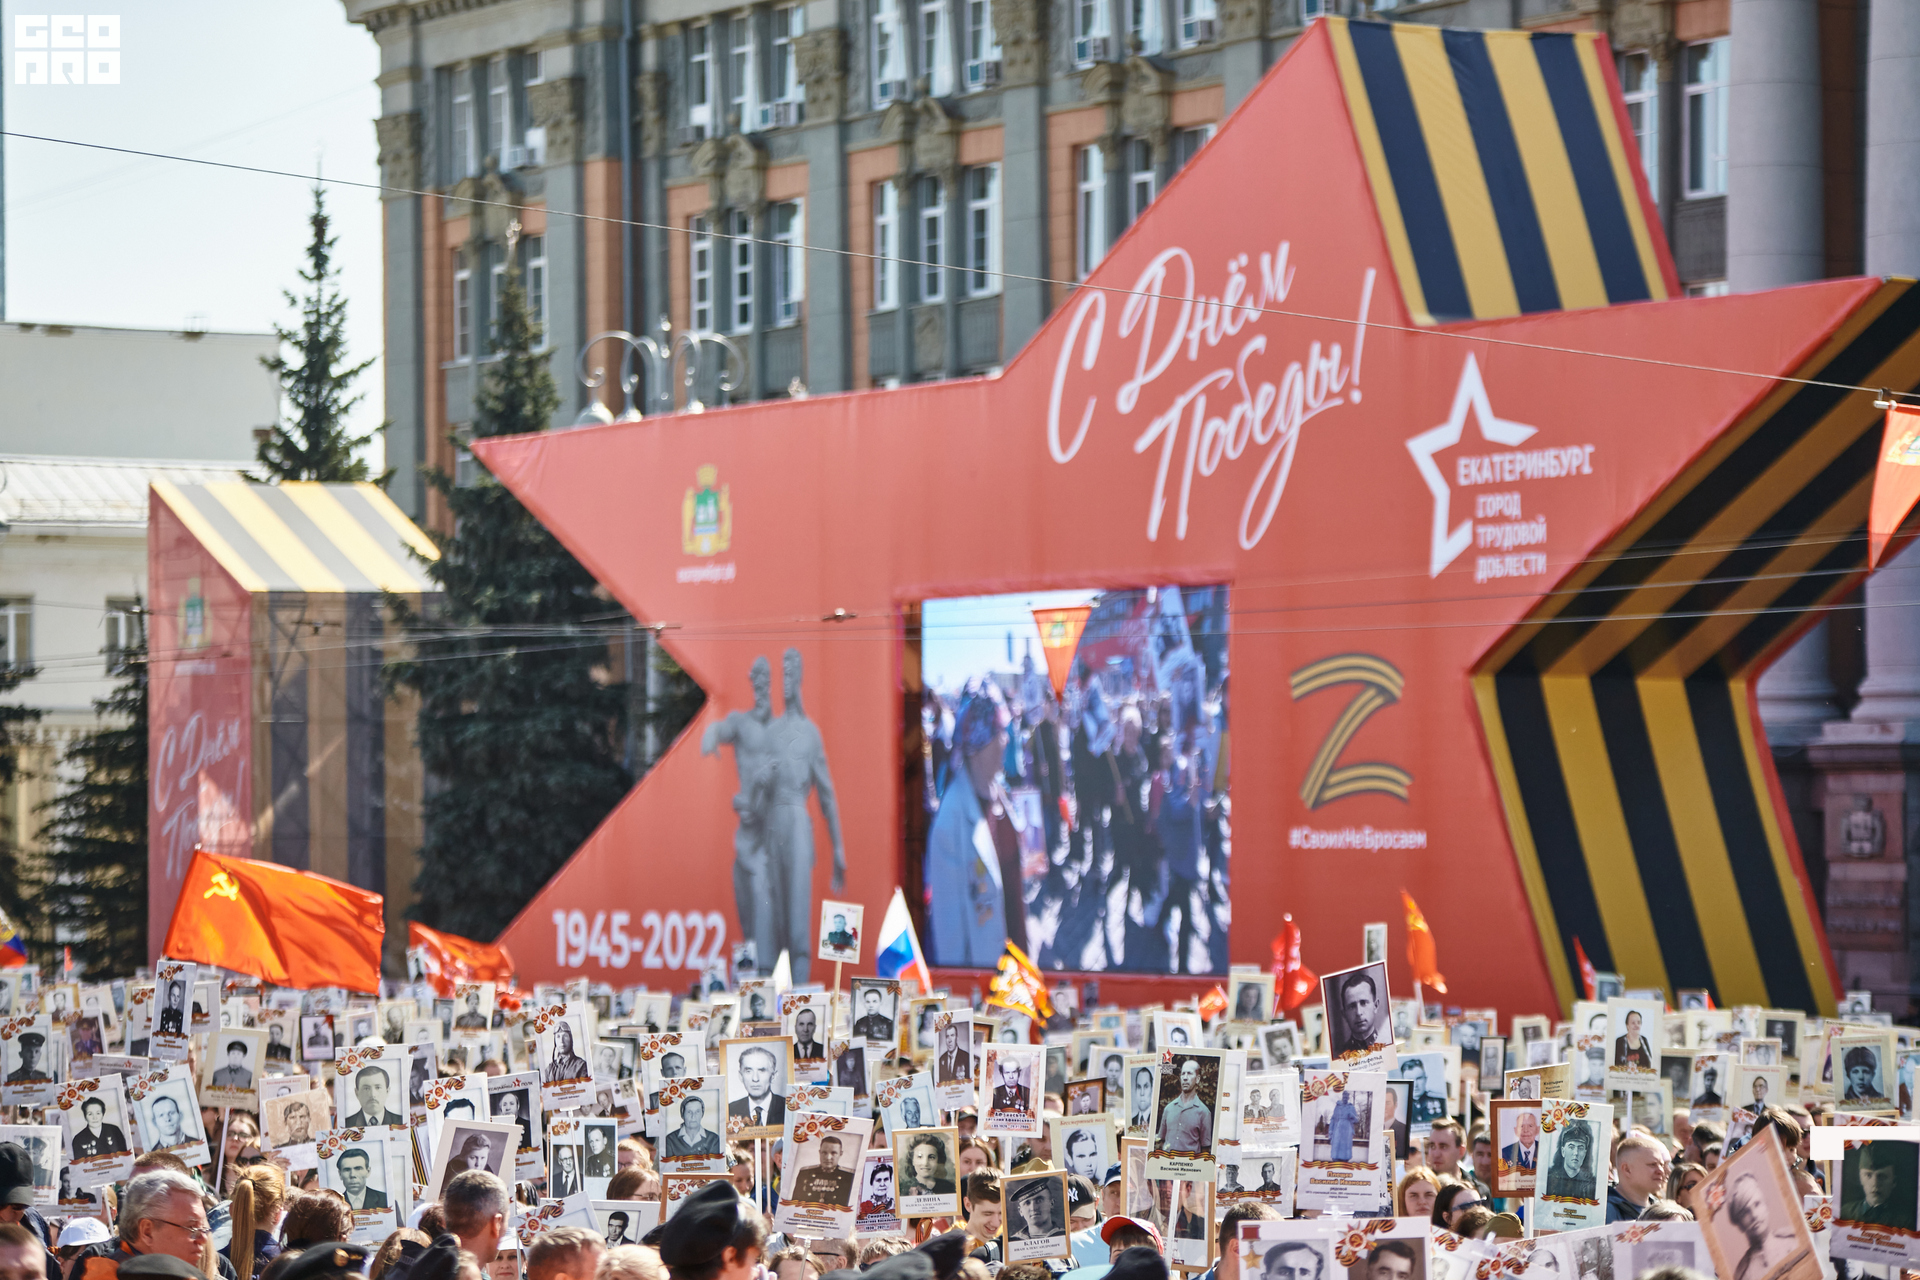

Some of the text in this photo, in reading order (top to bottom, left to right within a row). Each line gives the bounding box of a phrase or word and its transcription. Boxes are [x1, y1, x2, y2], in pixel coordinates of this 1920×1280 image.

[1048, 241, 1297, 464] С Днём
[1135, 268, 1377, 550] Победы!
[1456, 443, 1595, 487] ЕКАТЕРИНБУРГ
[1475, 491, 1522, 519] ГОРОД
[1474, 514, 1548, 550] ТРУДОВОЙ
[1474, 552, 1547, 583] ДОБЛЕСТИ
[552, 909, 727, 969] 1945-2022
